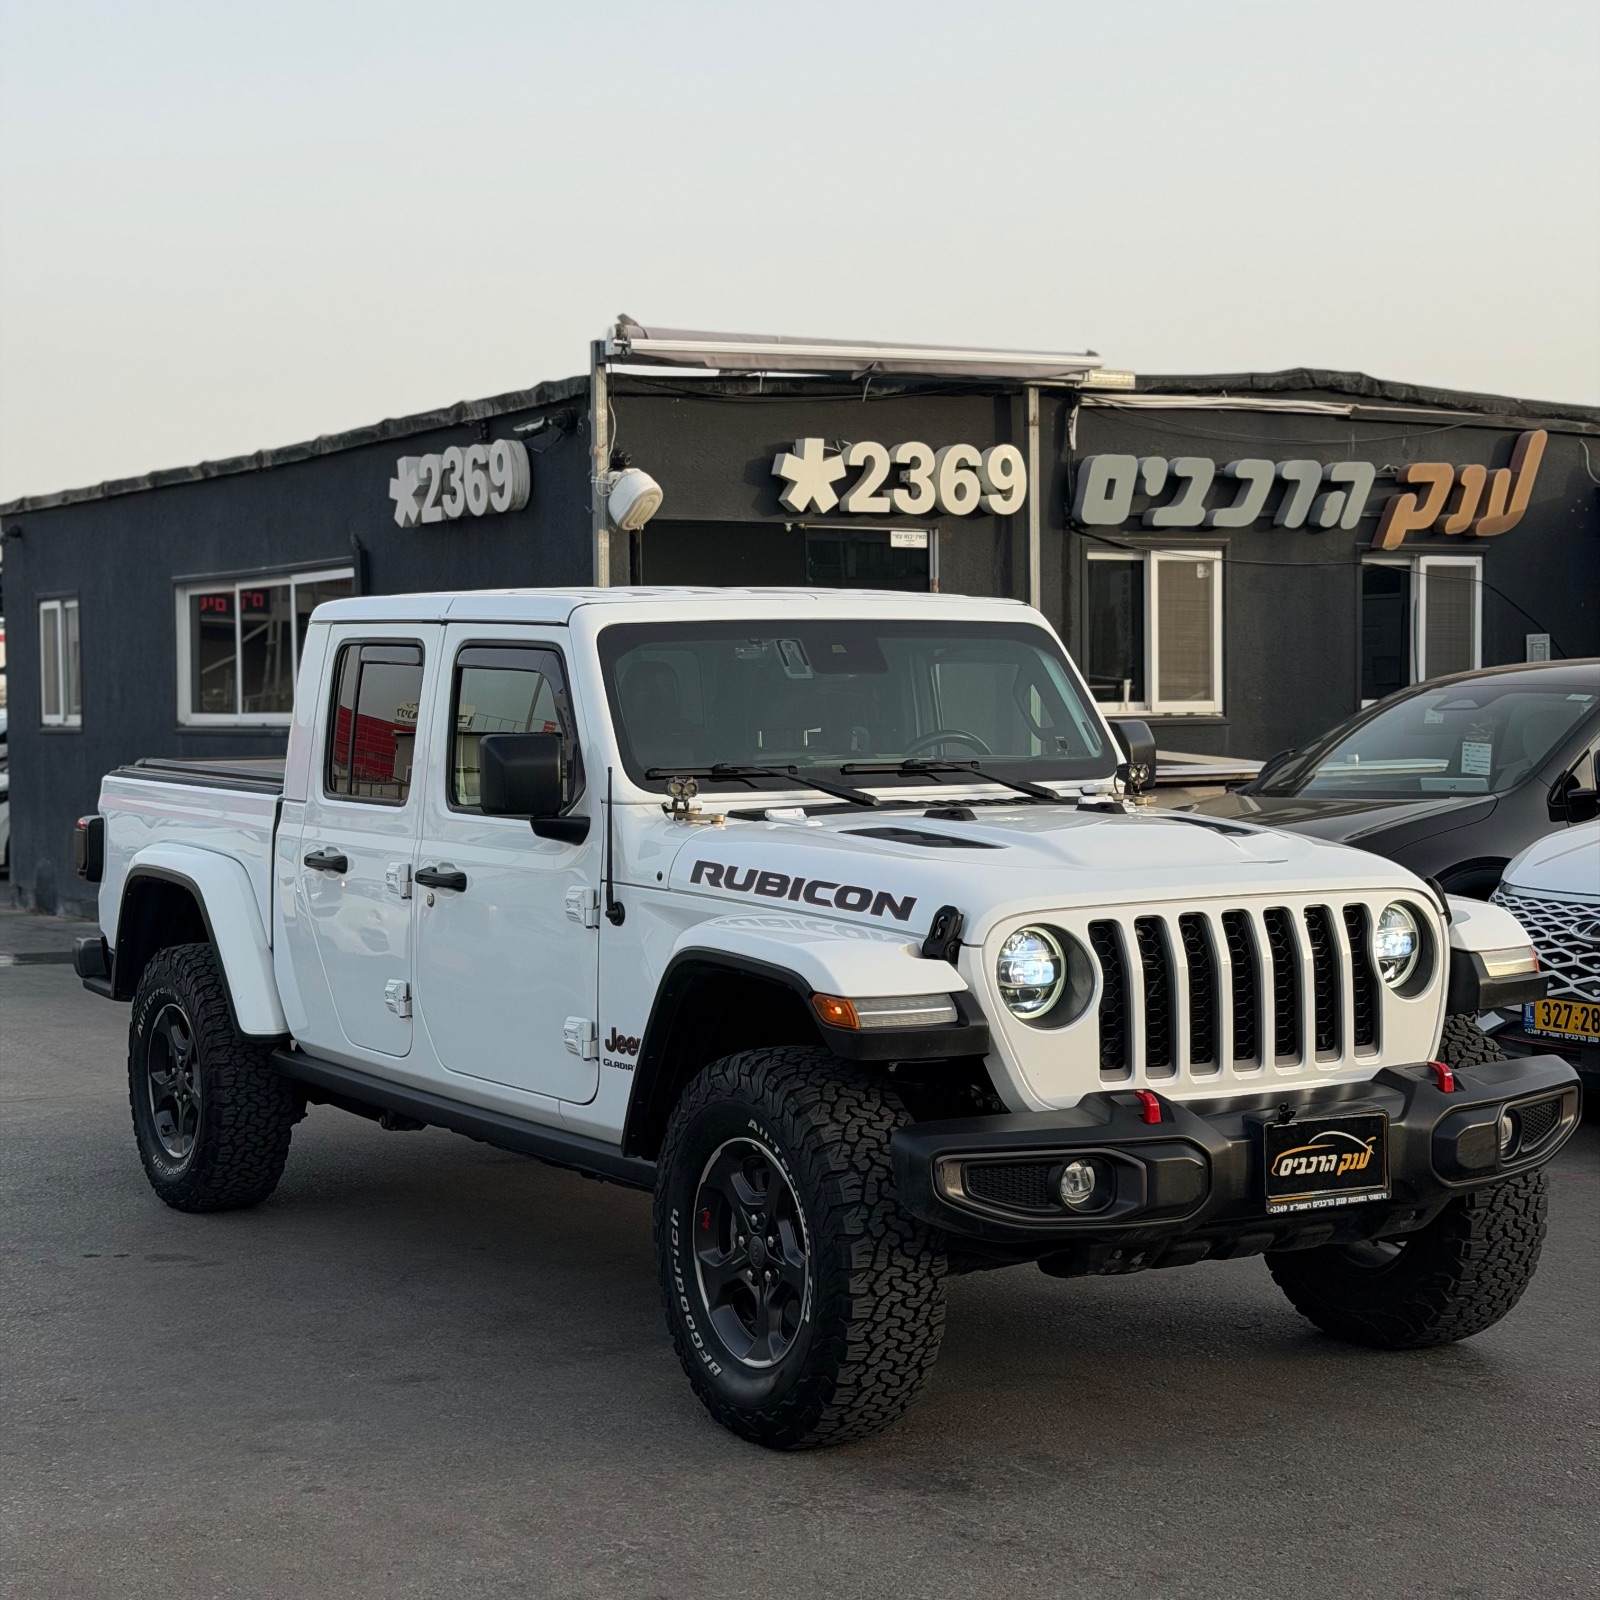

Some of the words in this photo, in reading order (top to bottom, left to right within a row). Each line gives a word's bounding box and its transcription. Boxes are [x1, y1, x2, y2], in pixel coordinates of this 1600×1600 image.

[1077, 454, 1376, 530] הרכבים
[1374, 429, 1548, 550] ענק
[689, 860, 918, 921] RUBICON
[603, 1058, 635, 1072] GLADIA
[1279, 1154, 1338, 1177] הרכבים
[1337, 1145, 1373, 1176] ענק
[669, 1208, 723, 1378] BFGoodrich
